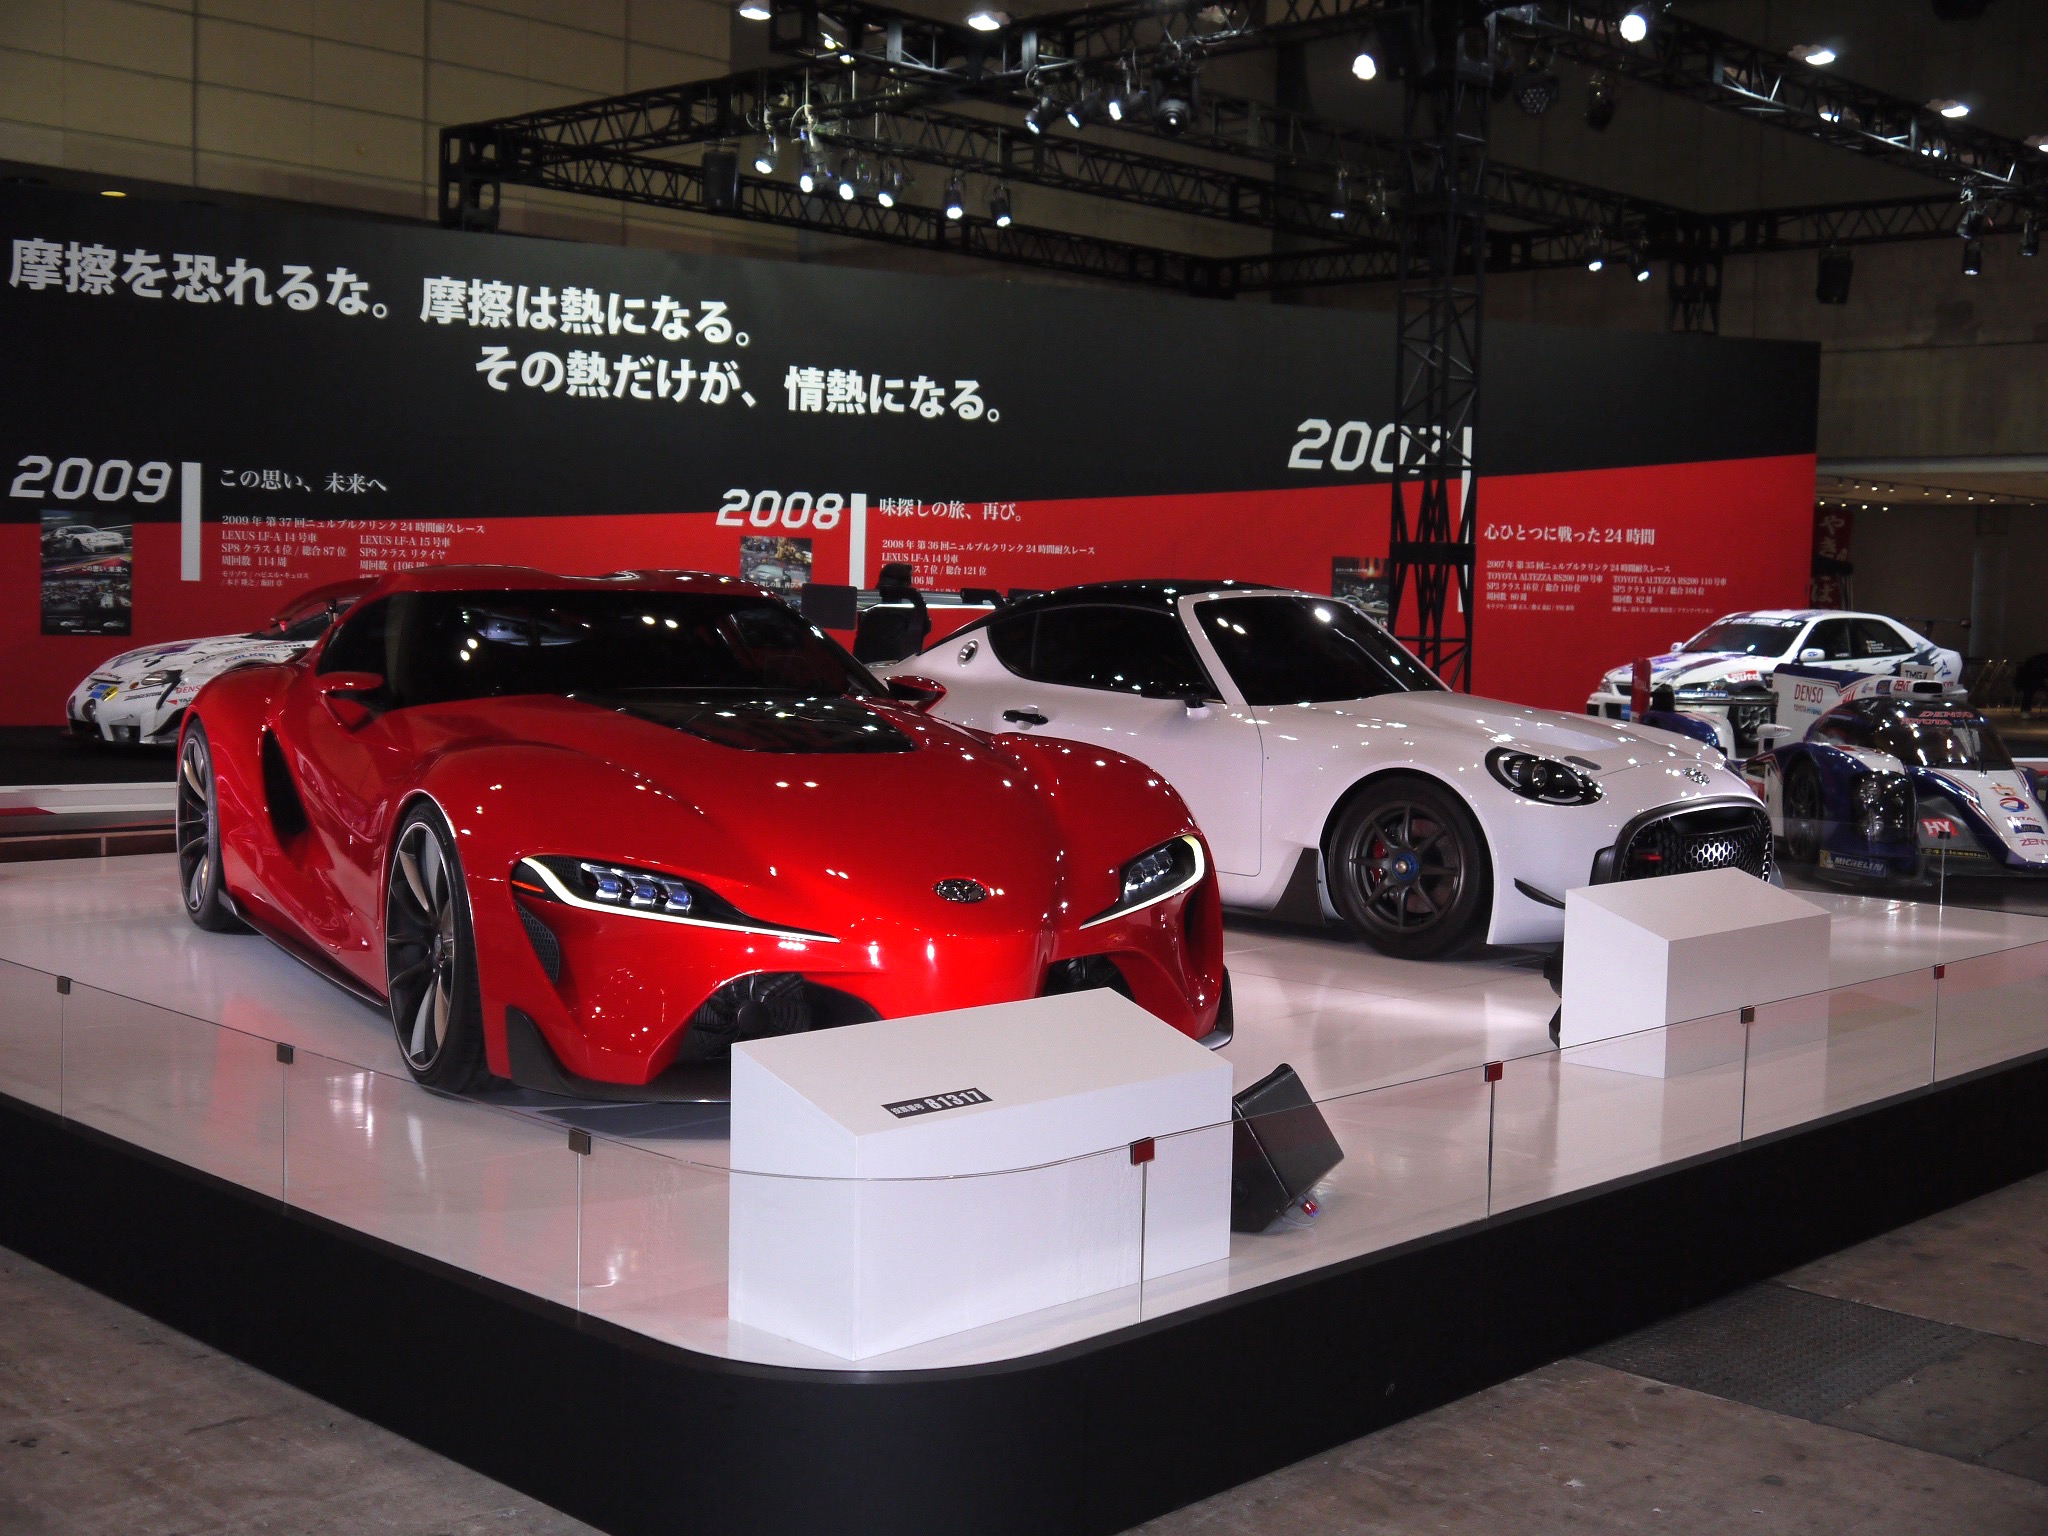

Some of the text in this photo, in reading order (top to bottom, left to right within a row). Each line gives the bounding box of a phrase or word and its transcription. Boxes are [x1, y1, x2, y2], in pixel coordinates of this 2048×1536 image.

[8, 238, 750, 348] 摩擦を恐れるな。 摩擦は熱になる。
[9, 455, 172, 503] 2009
[220, 467, 387, 494] この思い、未来へ
[715, 489, 844, 530] 2008
[879, 497, 1022, 522] 味探しの旅、再び。
[221, 530, 255, 541] LEXUS
[258, 531, 281, 541] LF-A
[360, 535, 392, 546] LEXUS
[394, 536, 416, 546] LF-A
[881, 552, 909, 562] LEXUS
[910, 553, 929, 563] LF-A
[1487, 572, 1517, 581] TOYOTA
[1520, 573, 1552, 582] ALTEZZA
[1613, 575, 1643, 584] TOYOTA
[1645, 576, 1676, 585] ALTEZZA
[175, 684, 201, 694] DENS
[1793, 684, 1824, 704] DENSO
[1923, 820, 1951, 835] HY
[1833, 856, 1885, 871] MICHELIN
[923, 1090, 984, 1109] 81317
